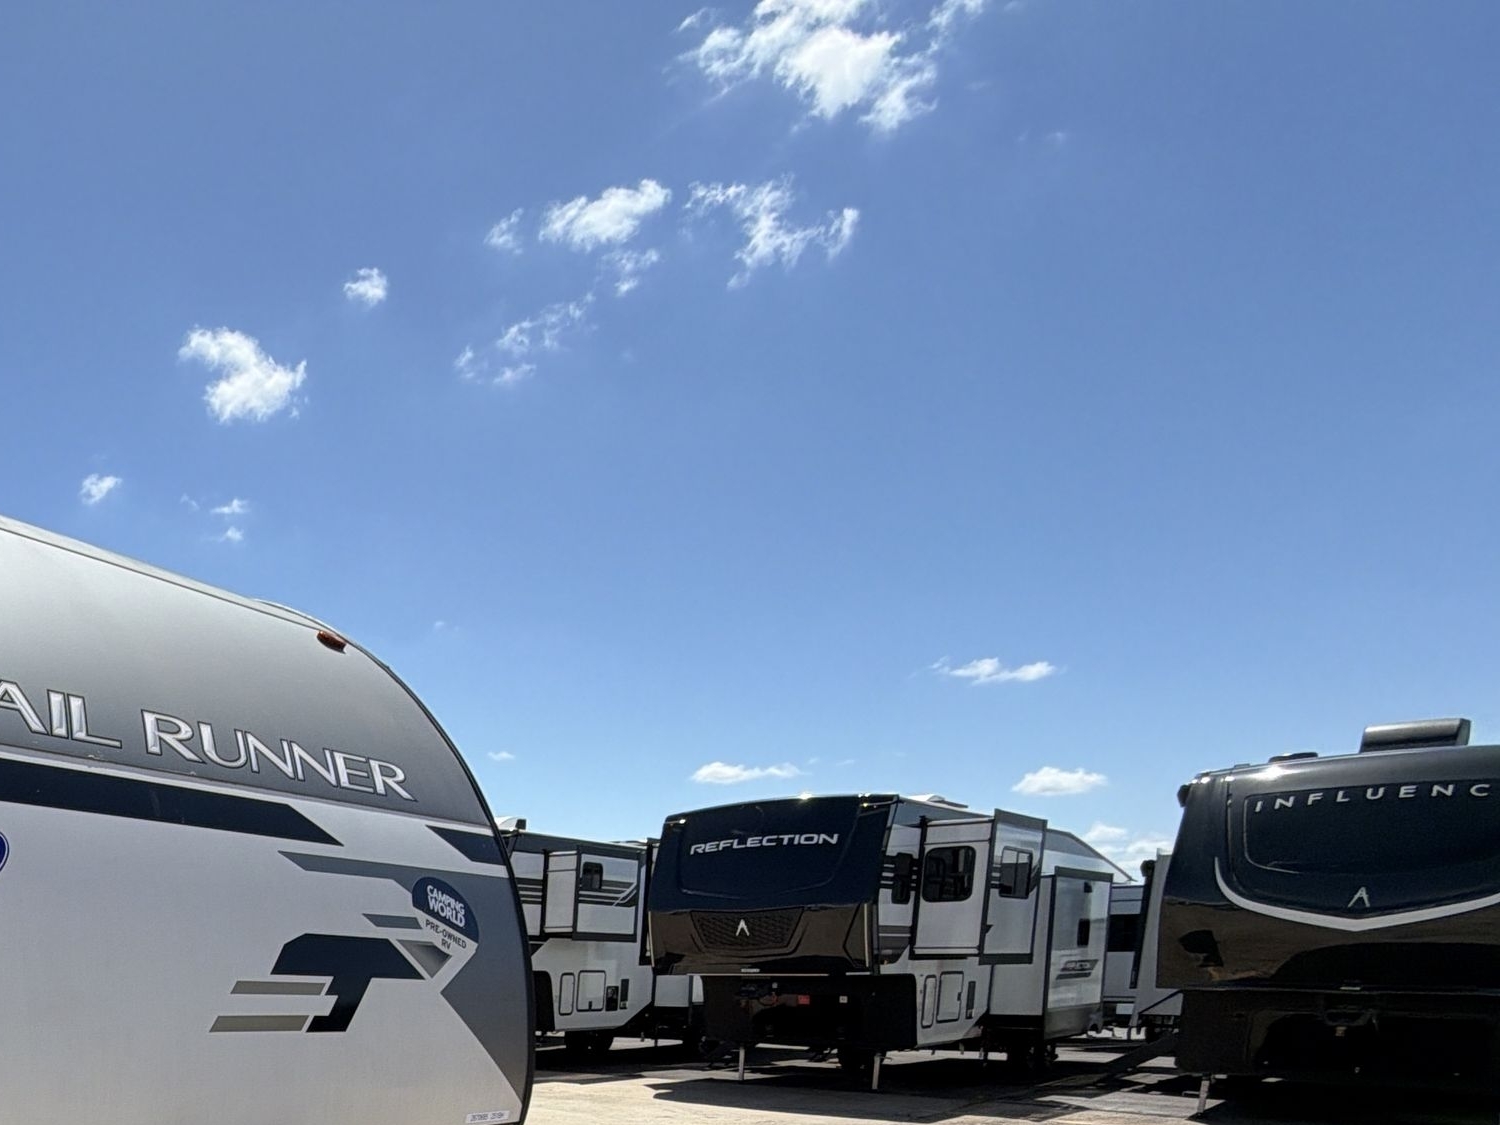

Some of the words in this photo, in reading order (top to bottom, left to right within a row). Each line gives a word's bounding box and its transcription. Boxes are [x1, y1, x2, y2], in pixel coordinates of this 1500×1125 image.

[140, 708, 418, 802] RUNNER
[1254, 783, 1491, 813] INFLUENC
[689, 833, 839, 855] REFLECTION
[426, 884, 466, 916] CAMPING
[427, 894, 466, 928] WORLD
[425, 919, 467, 949] PRE-OWNED
[441, 938, 452, 950] RV
